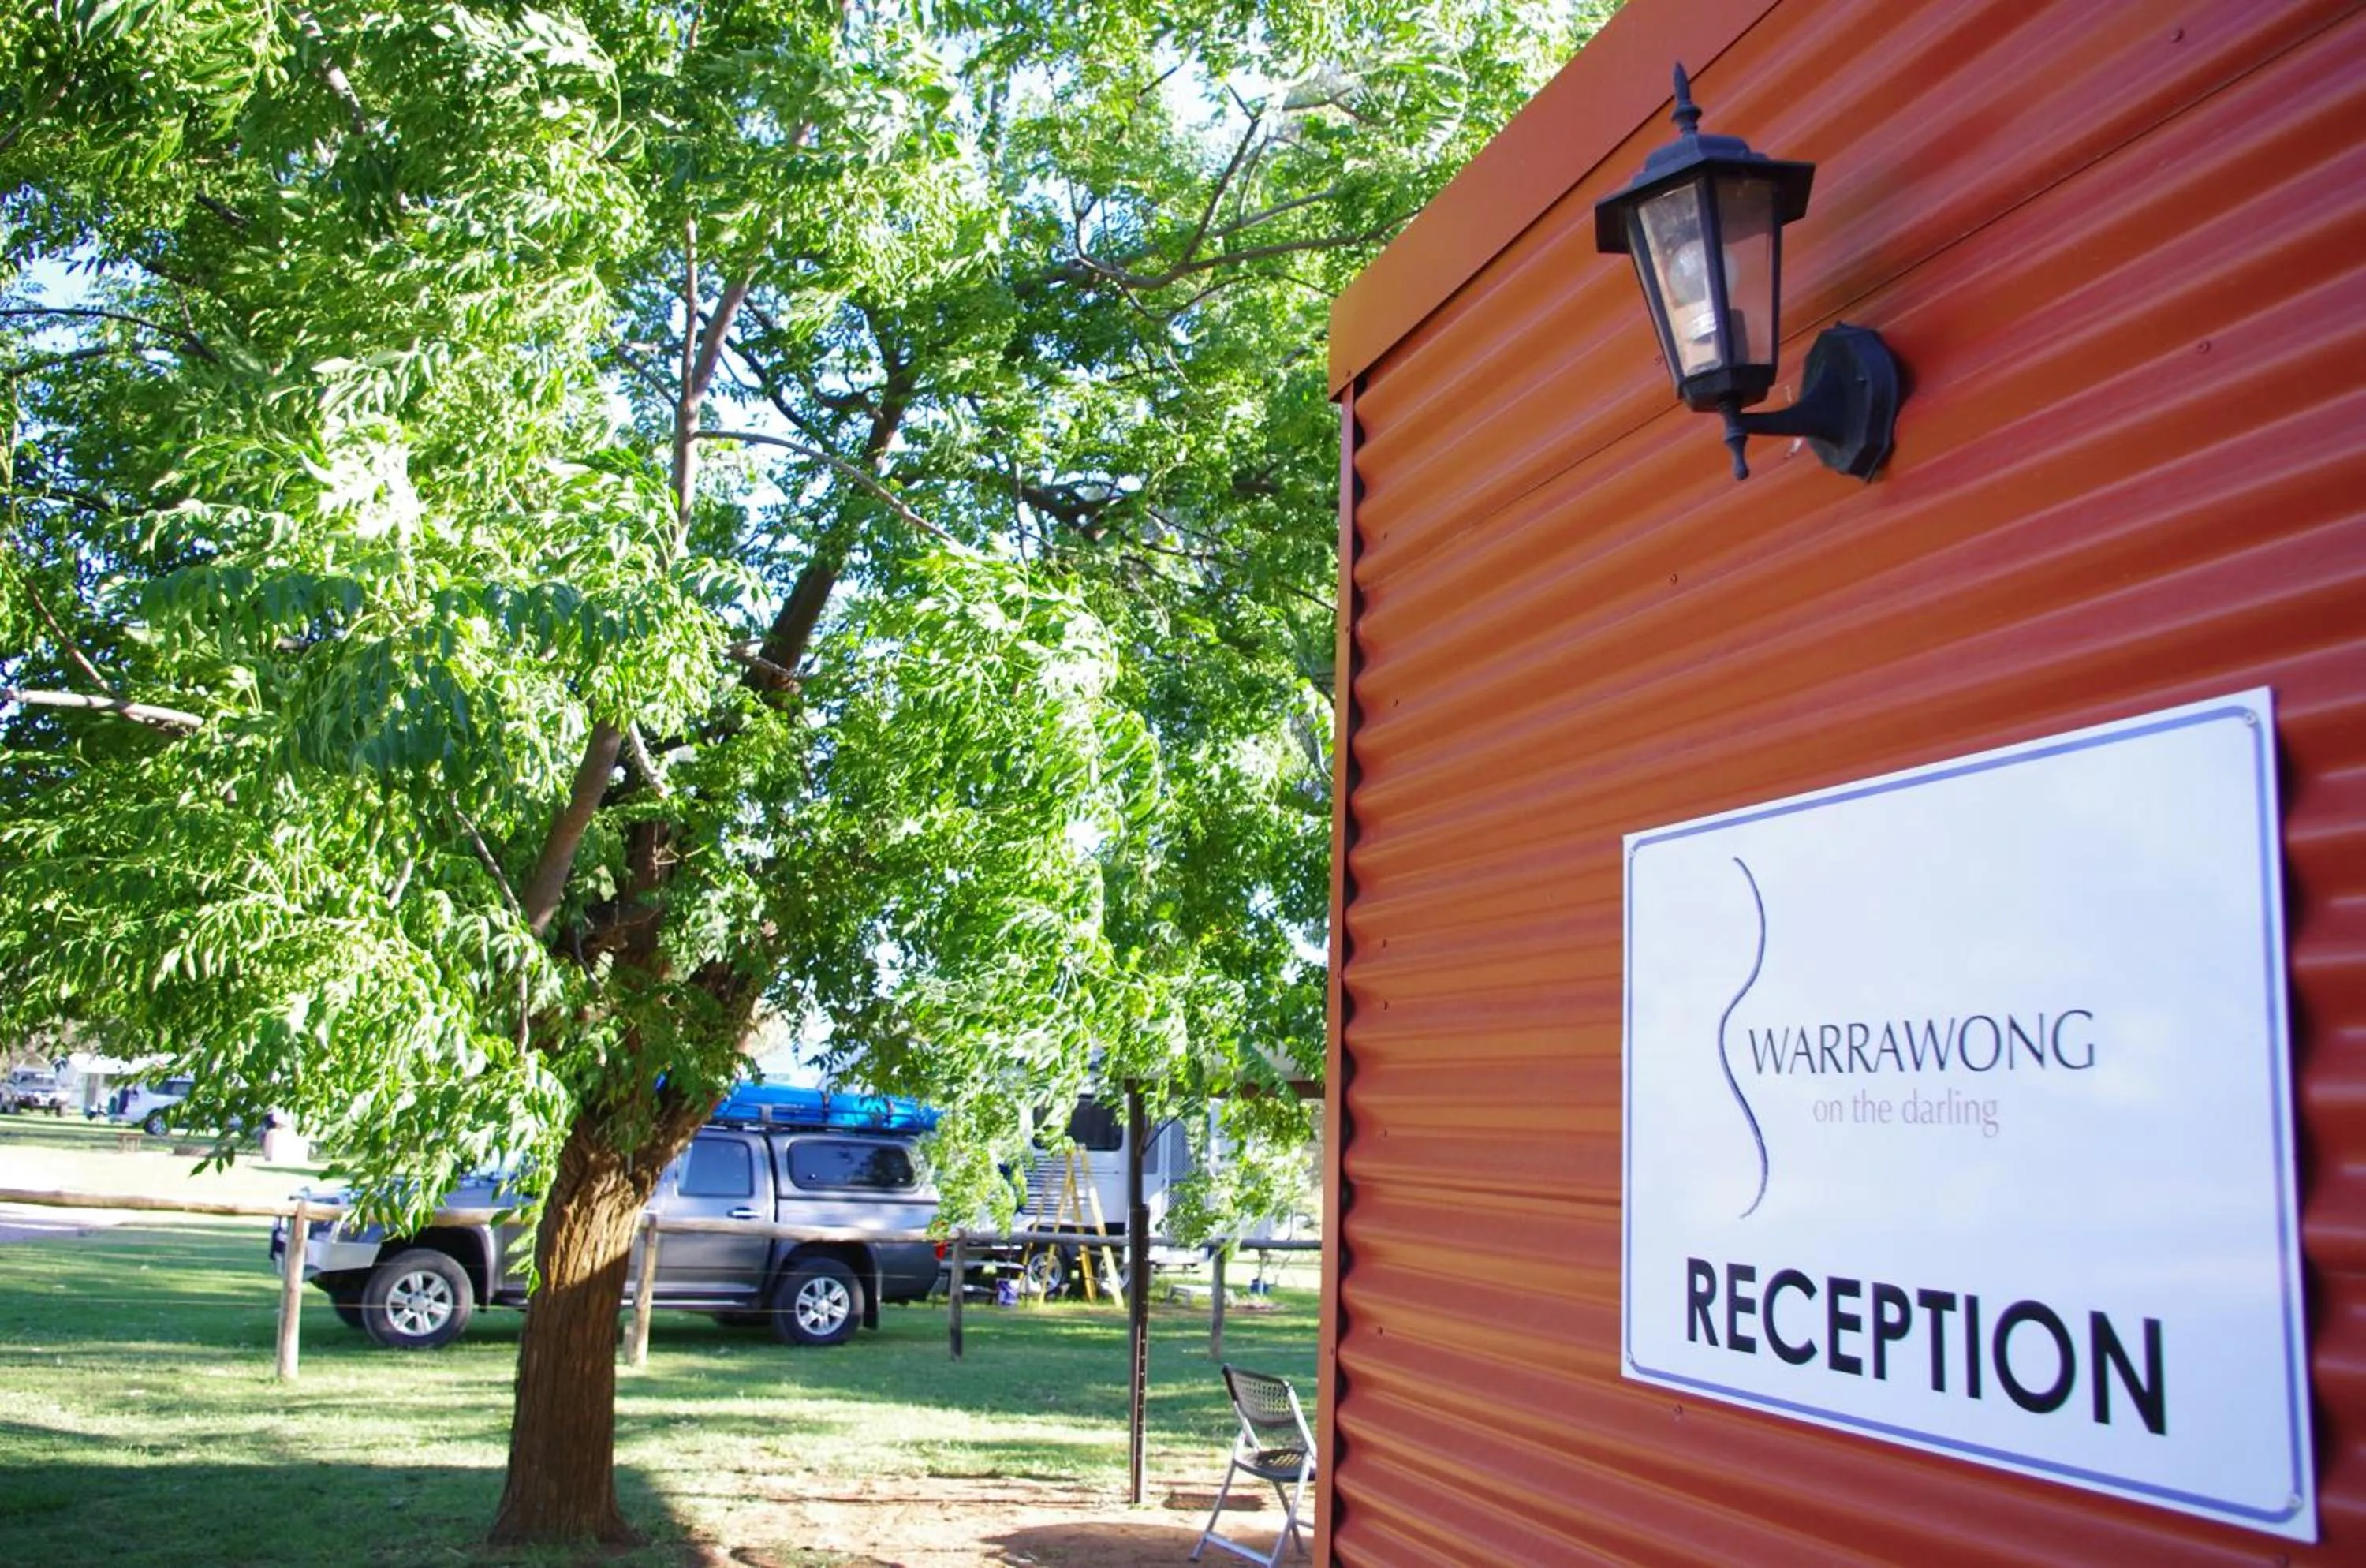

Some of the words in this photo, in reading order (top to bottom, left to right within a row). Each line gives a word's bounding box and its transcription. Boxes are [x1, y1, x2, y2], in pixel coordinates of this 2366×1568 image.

[1748, 1008, 2095, 1075] WARRAWONG
[1812, 1099, 1844, 1124] on
[1852, 1088, 1894, 1124] the
[1901, 1087, 2001, 1139] darling
[1686, 1256, 2167, 1436] RECEPTION
